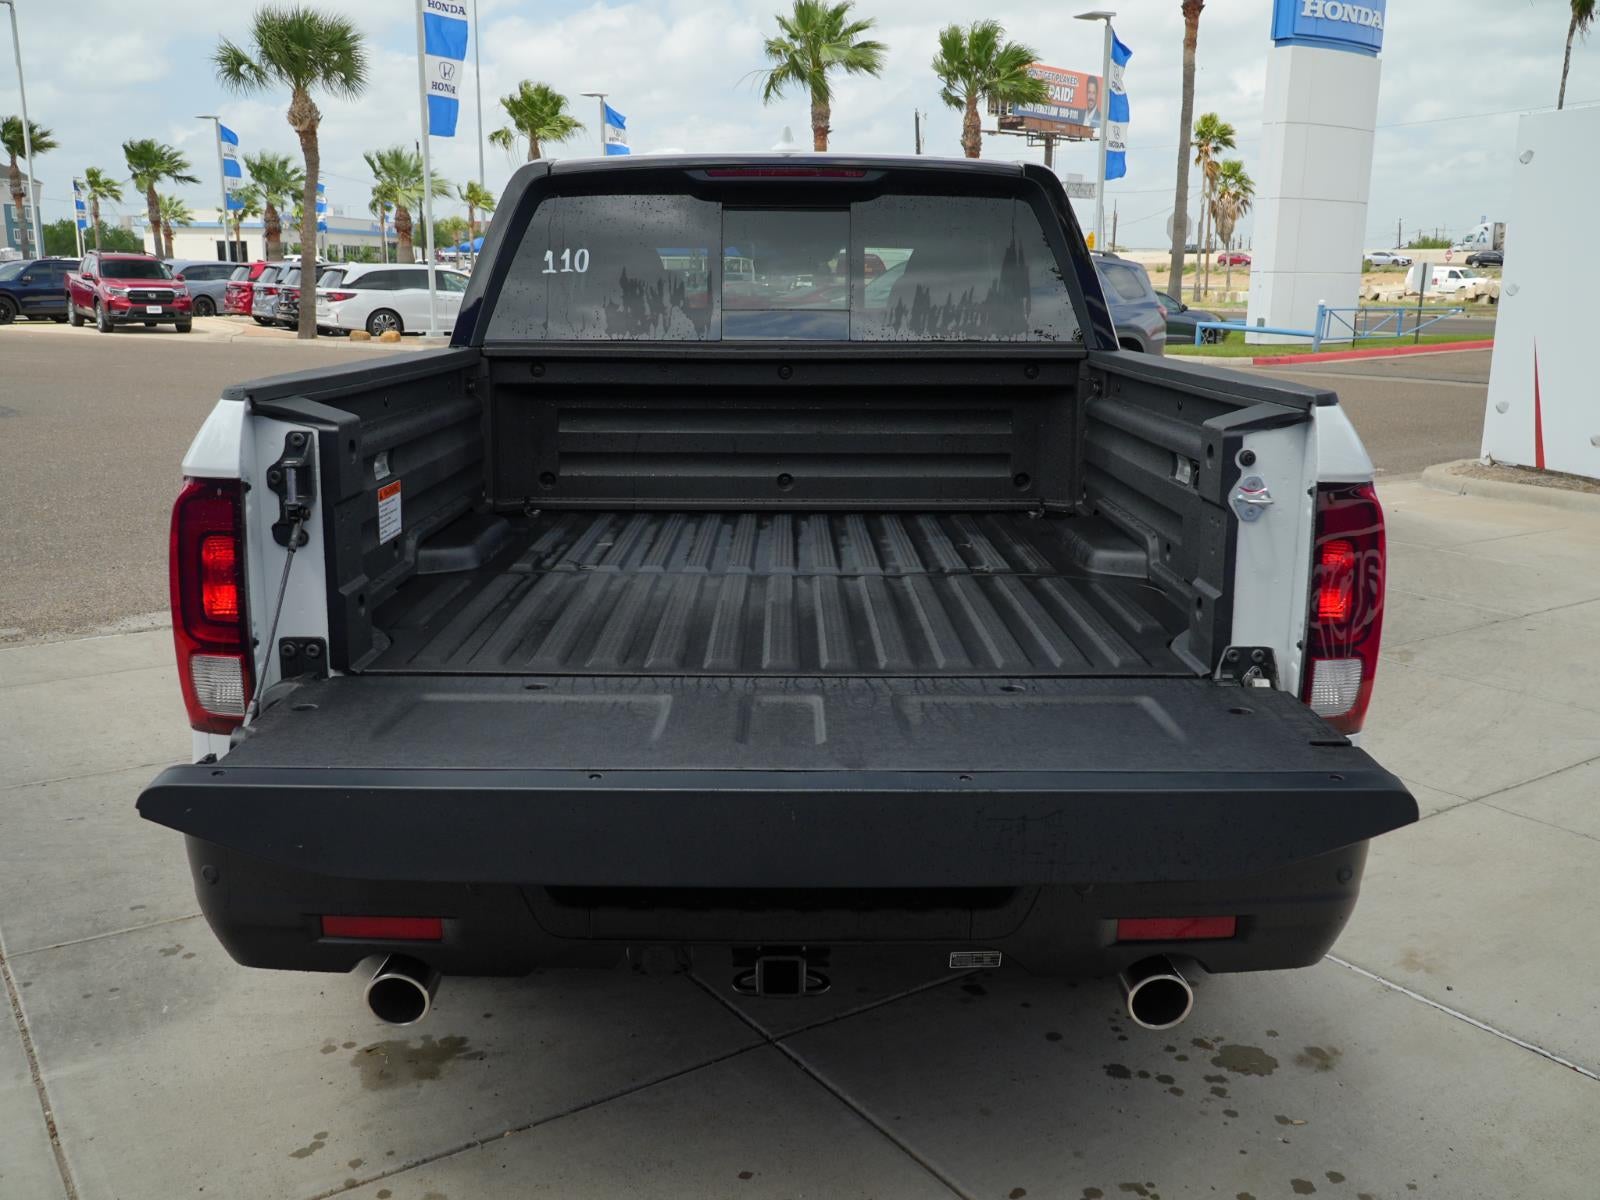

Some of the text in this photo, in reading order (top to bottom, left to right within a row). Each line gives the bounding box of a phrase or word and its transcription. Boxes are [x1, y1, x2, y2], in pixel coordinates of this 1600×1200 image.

[428, 0, 466, 15] HONDA
[1301, 0, 1384, 29] HONDA
[1048, 84, 1073, 103] PAID!
[541, 248, 590, 274] 110
